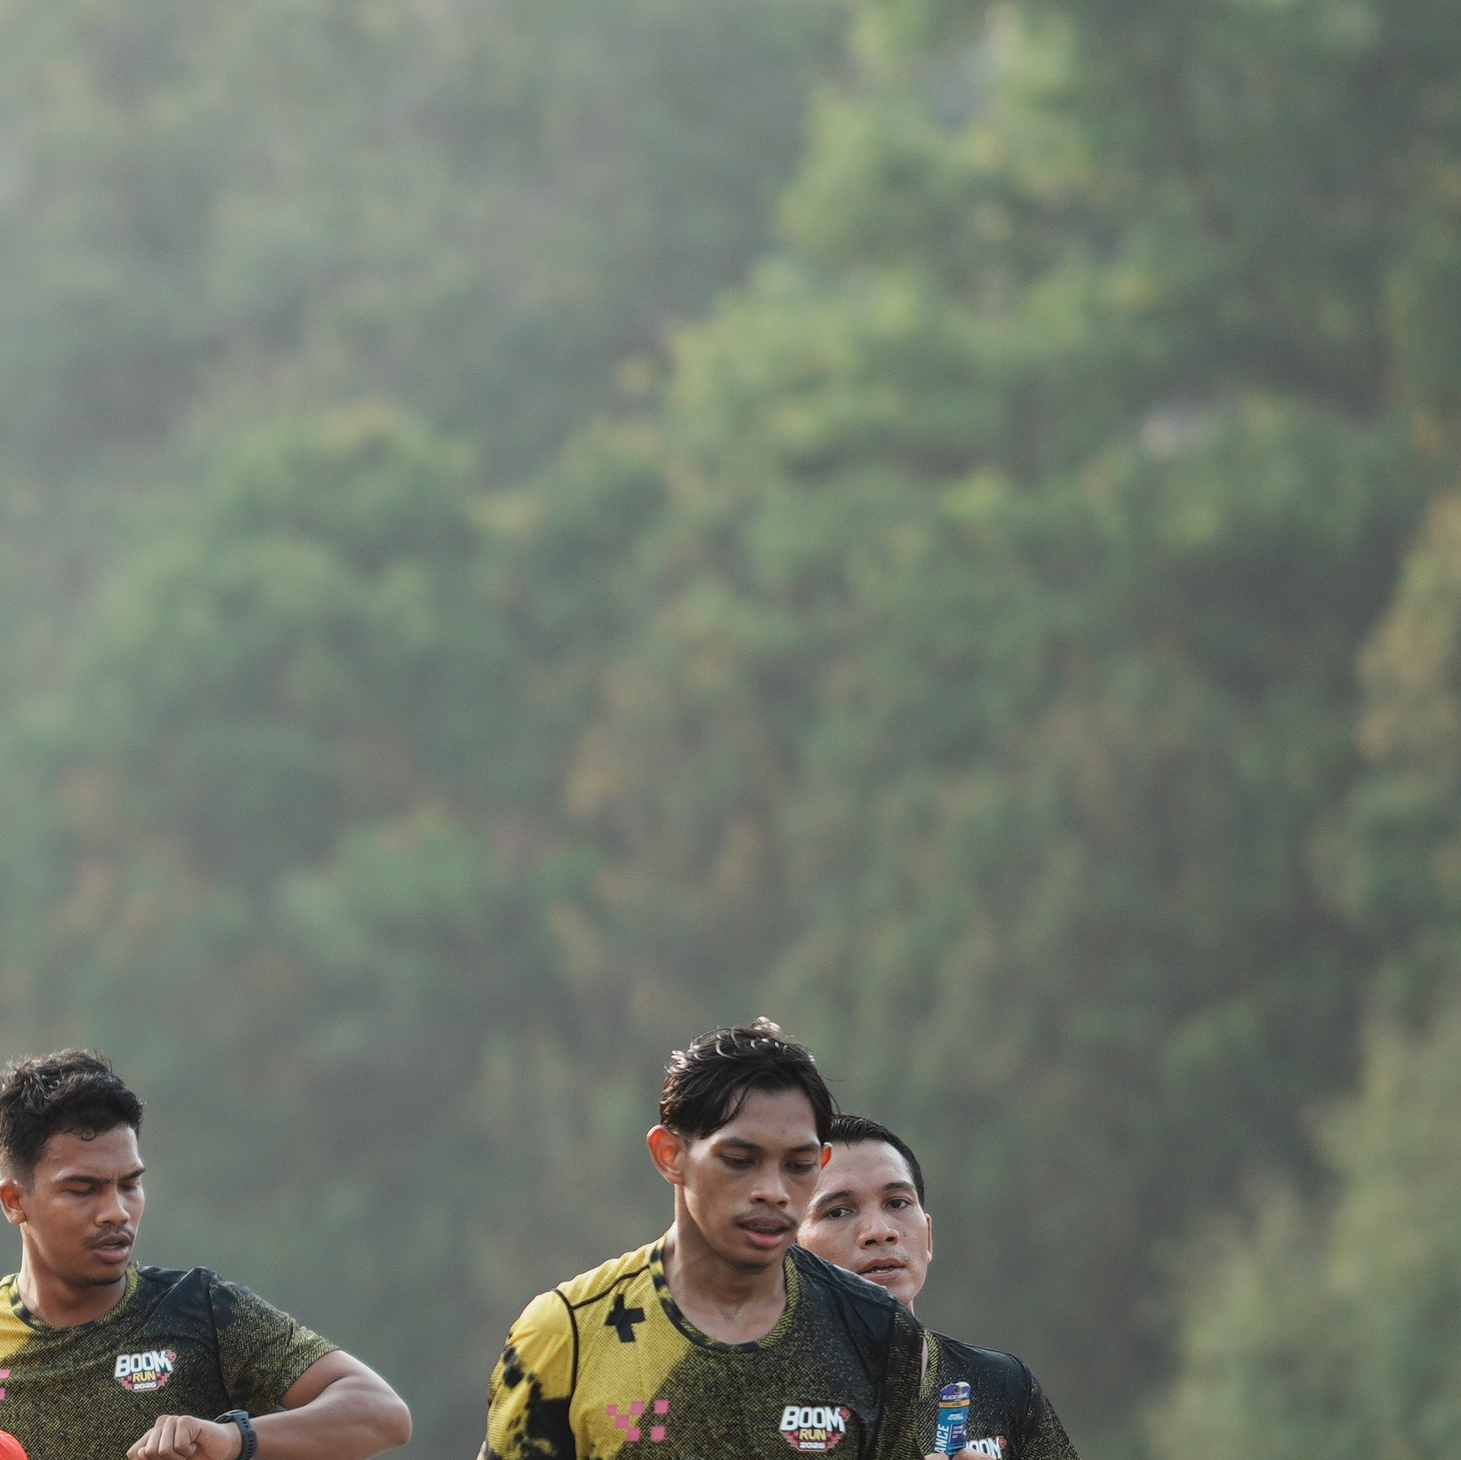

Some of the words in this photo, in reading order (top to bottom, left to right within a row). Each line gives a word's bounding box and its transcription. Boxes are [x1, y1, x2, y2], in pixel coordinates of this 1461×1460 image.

[114, 1350, 173, 1377] BOOM
[133, 1371, 156, 1383] RUN
[779, 1405, 846, 1432] BOOM
[799, 1428, 826, 1440] RUN
